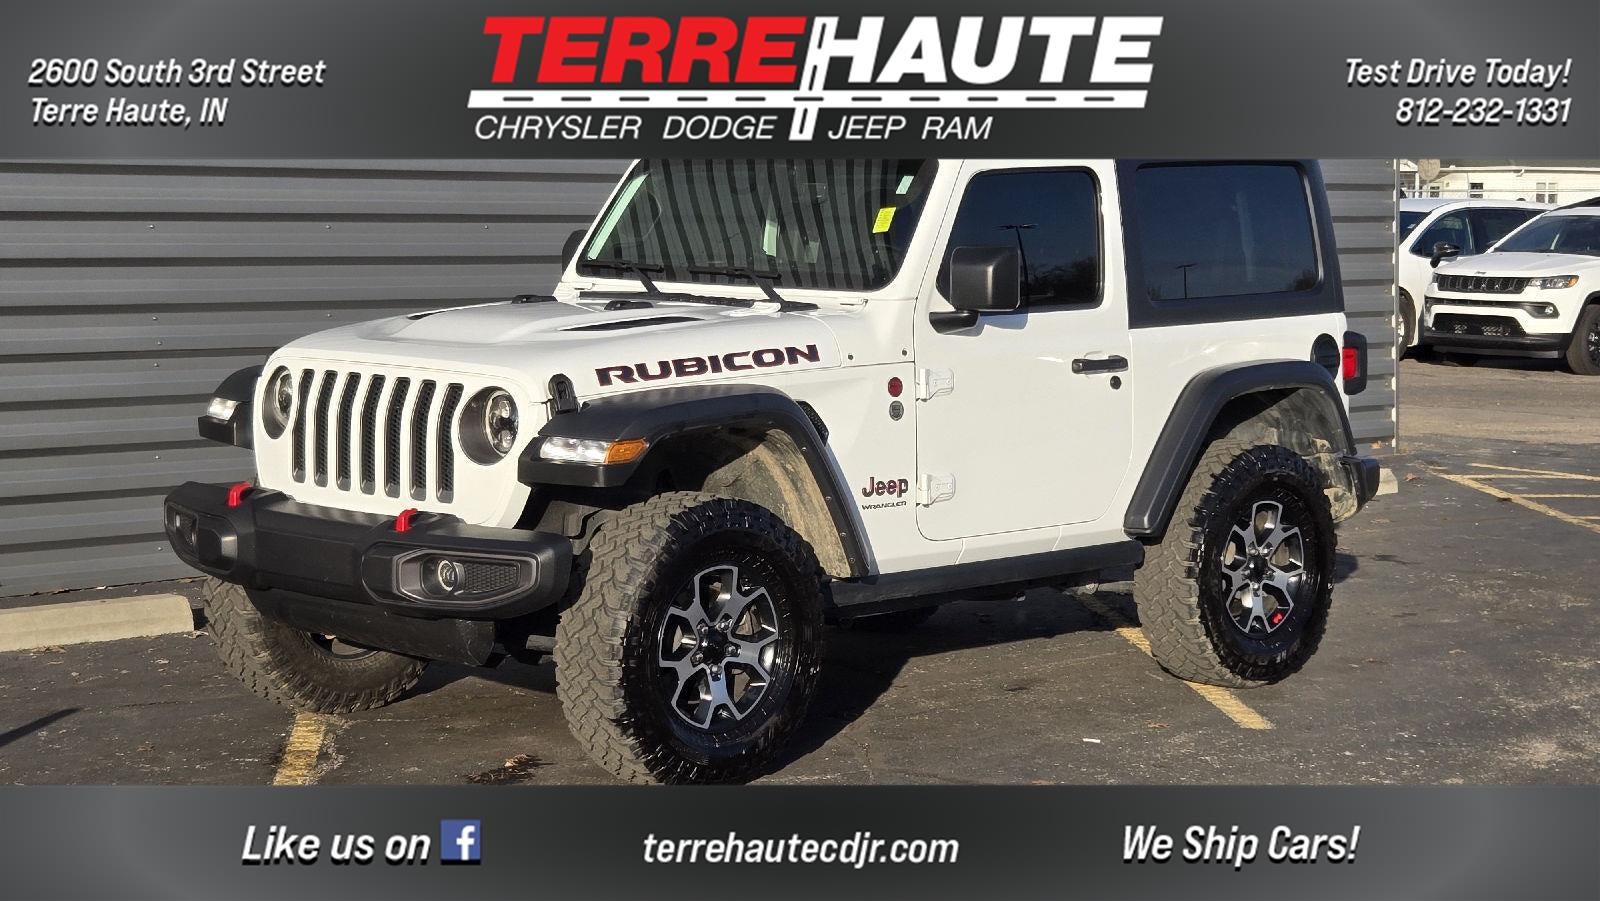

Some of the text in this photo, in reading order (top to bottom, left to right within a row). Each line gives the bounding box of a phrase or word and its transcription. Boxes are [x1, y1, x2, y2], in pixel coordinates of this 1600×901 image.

[595, 344, 820, 386] RUBICON
[861, 476, 909, 498] Jeep
[861, 500, 907, 510] WRANGLER
